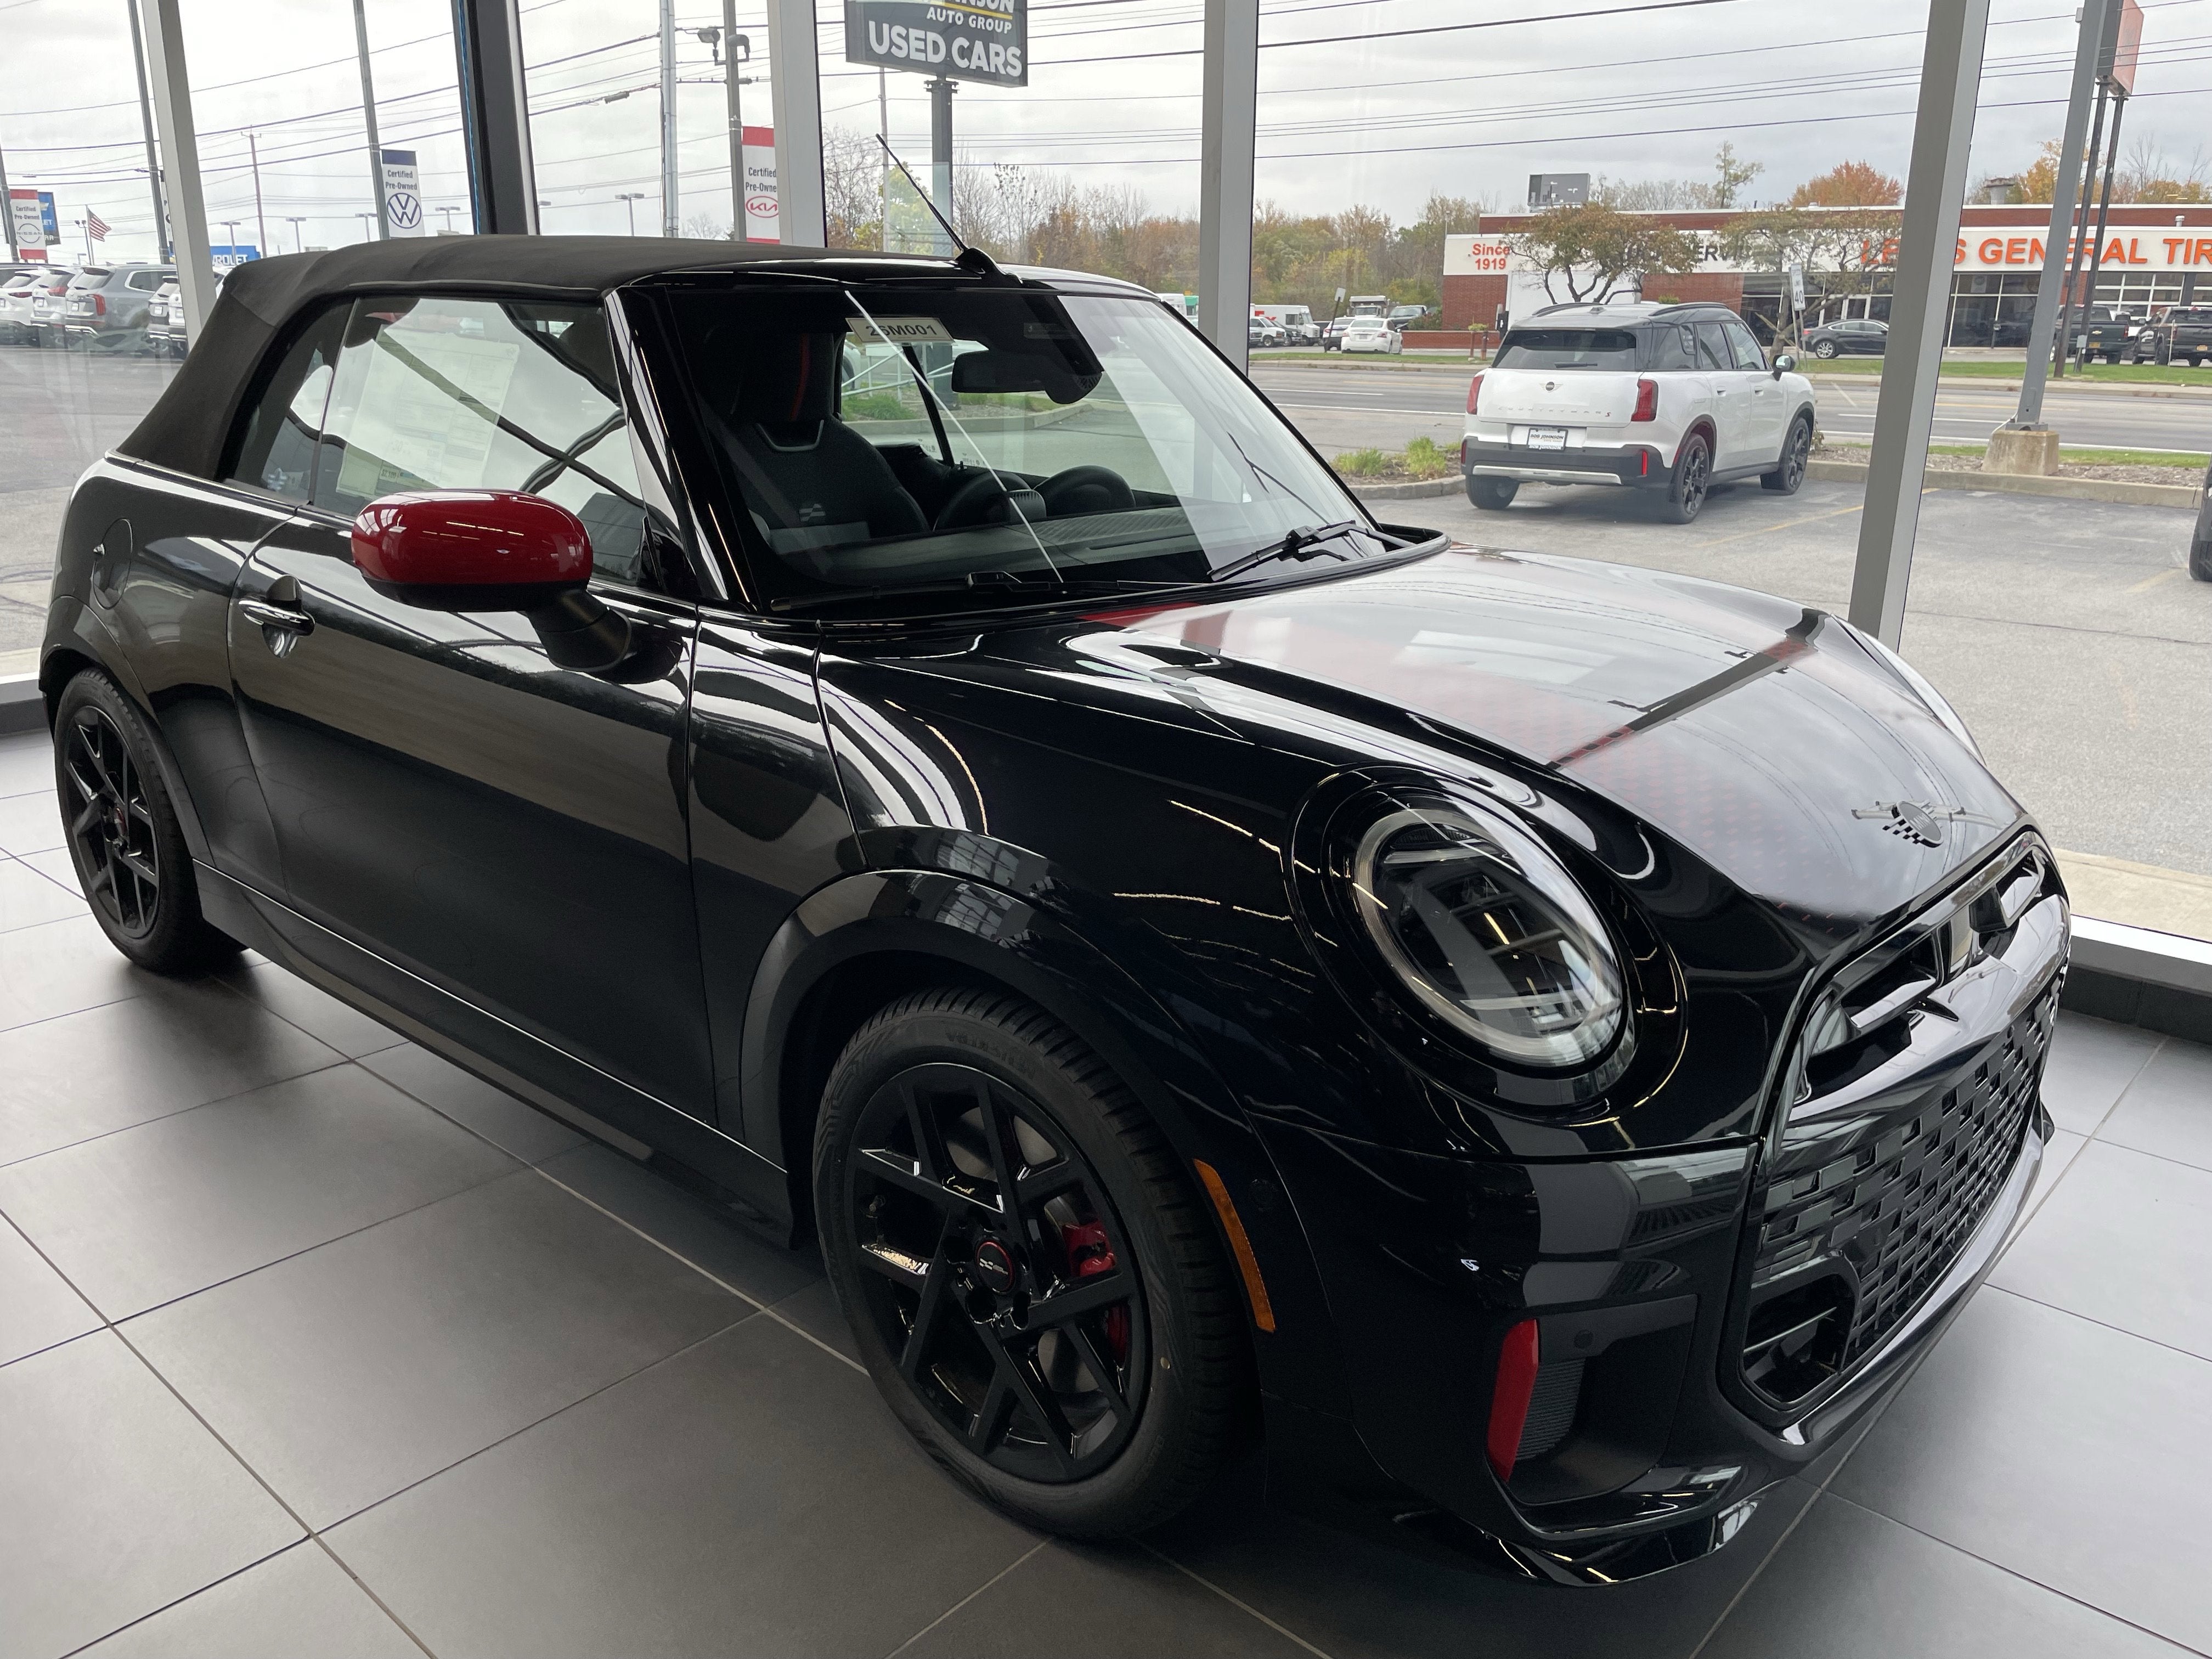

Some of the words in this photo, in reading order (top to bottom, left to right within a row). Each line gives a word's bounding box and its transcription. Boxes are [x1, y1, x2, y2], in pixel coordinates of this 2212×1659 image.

[926, 7, 964, 25] AUTO
[968, 15, 1012, 34] GROUP
[868, 20, 946, 64] USED
[951, 36, 1022, 77] CARS
[387, 170, 413, 179] Certified
[748, 167, 777, 178] Certified
[385, 182, 417, 190] Pre-Owned
[746, 182, 777, 193] Pre-Owne
[750, 202, 777, 212] KIA
[1472, 243, 1510, 256] Since
[2163, 238, 2212, 264] TIR
[1475, 258, 1506, 270] 1919
[1795, 290, 1804, 304] 40
